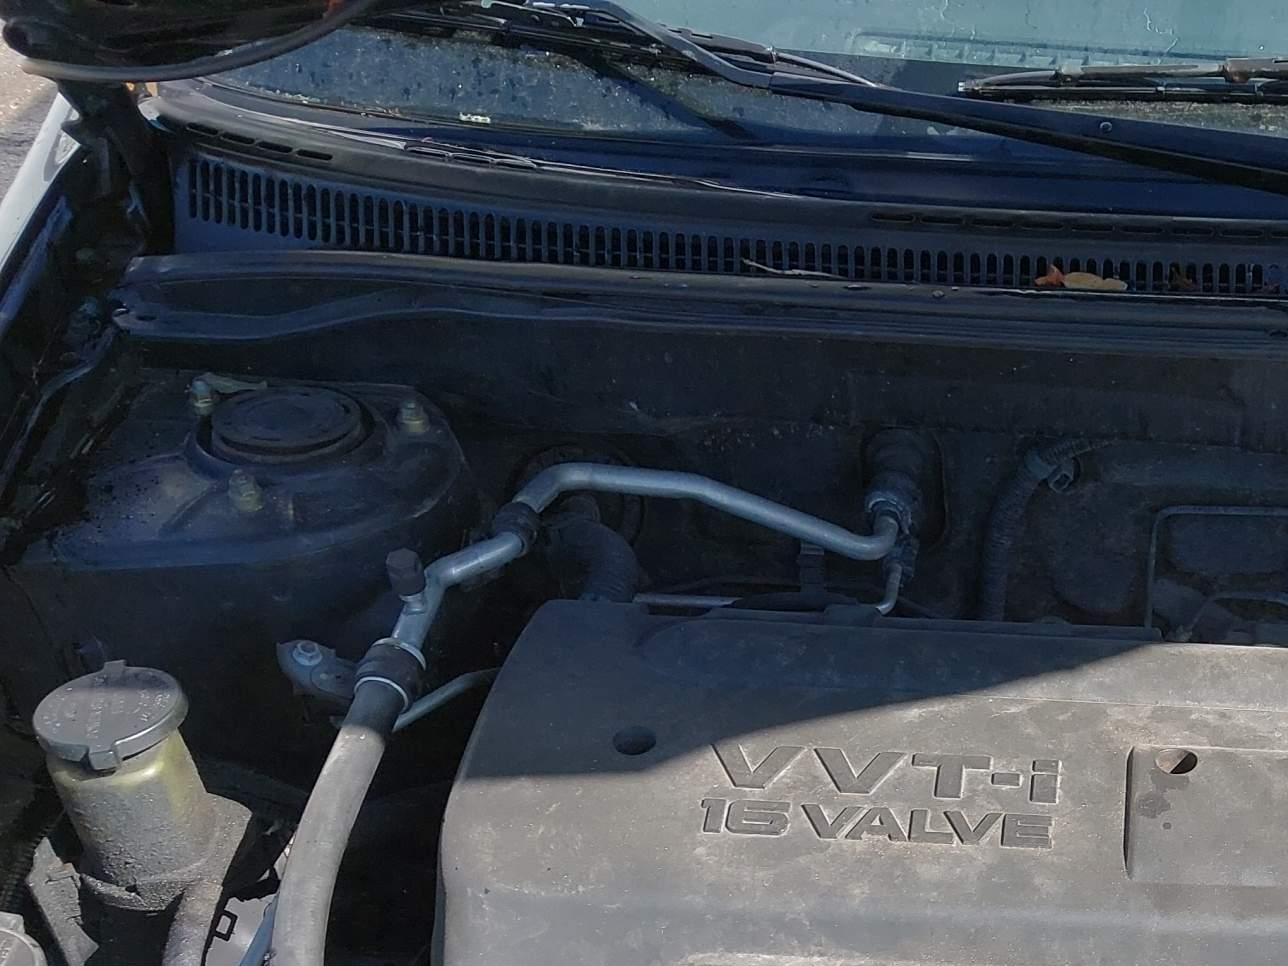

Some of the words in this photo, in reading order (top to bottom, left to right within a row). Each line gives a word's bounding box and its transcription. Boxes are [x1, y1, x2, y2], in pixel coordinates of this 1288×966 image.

[709, 743, 1063, 805] VVT-i
[700, 797, 791, 836] 16
[800, 802, 1055, 850] VALVE
